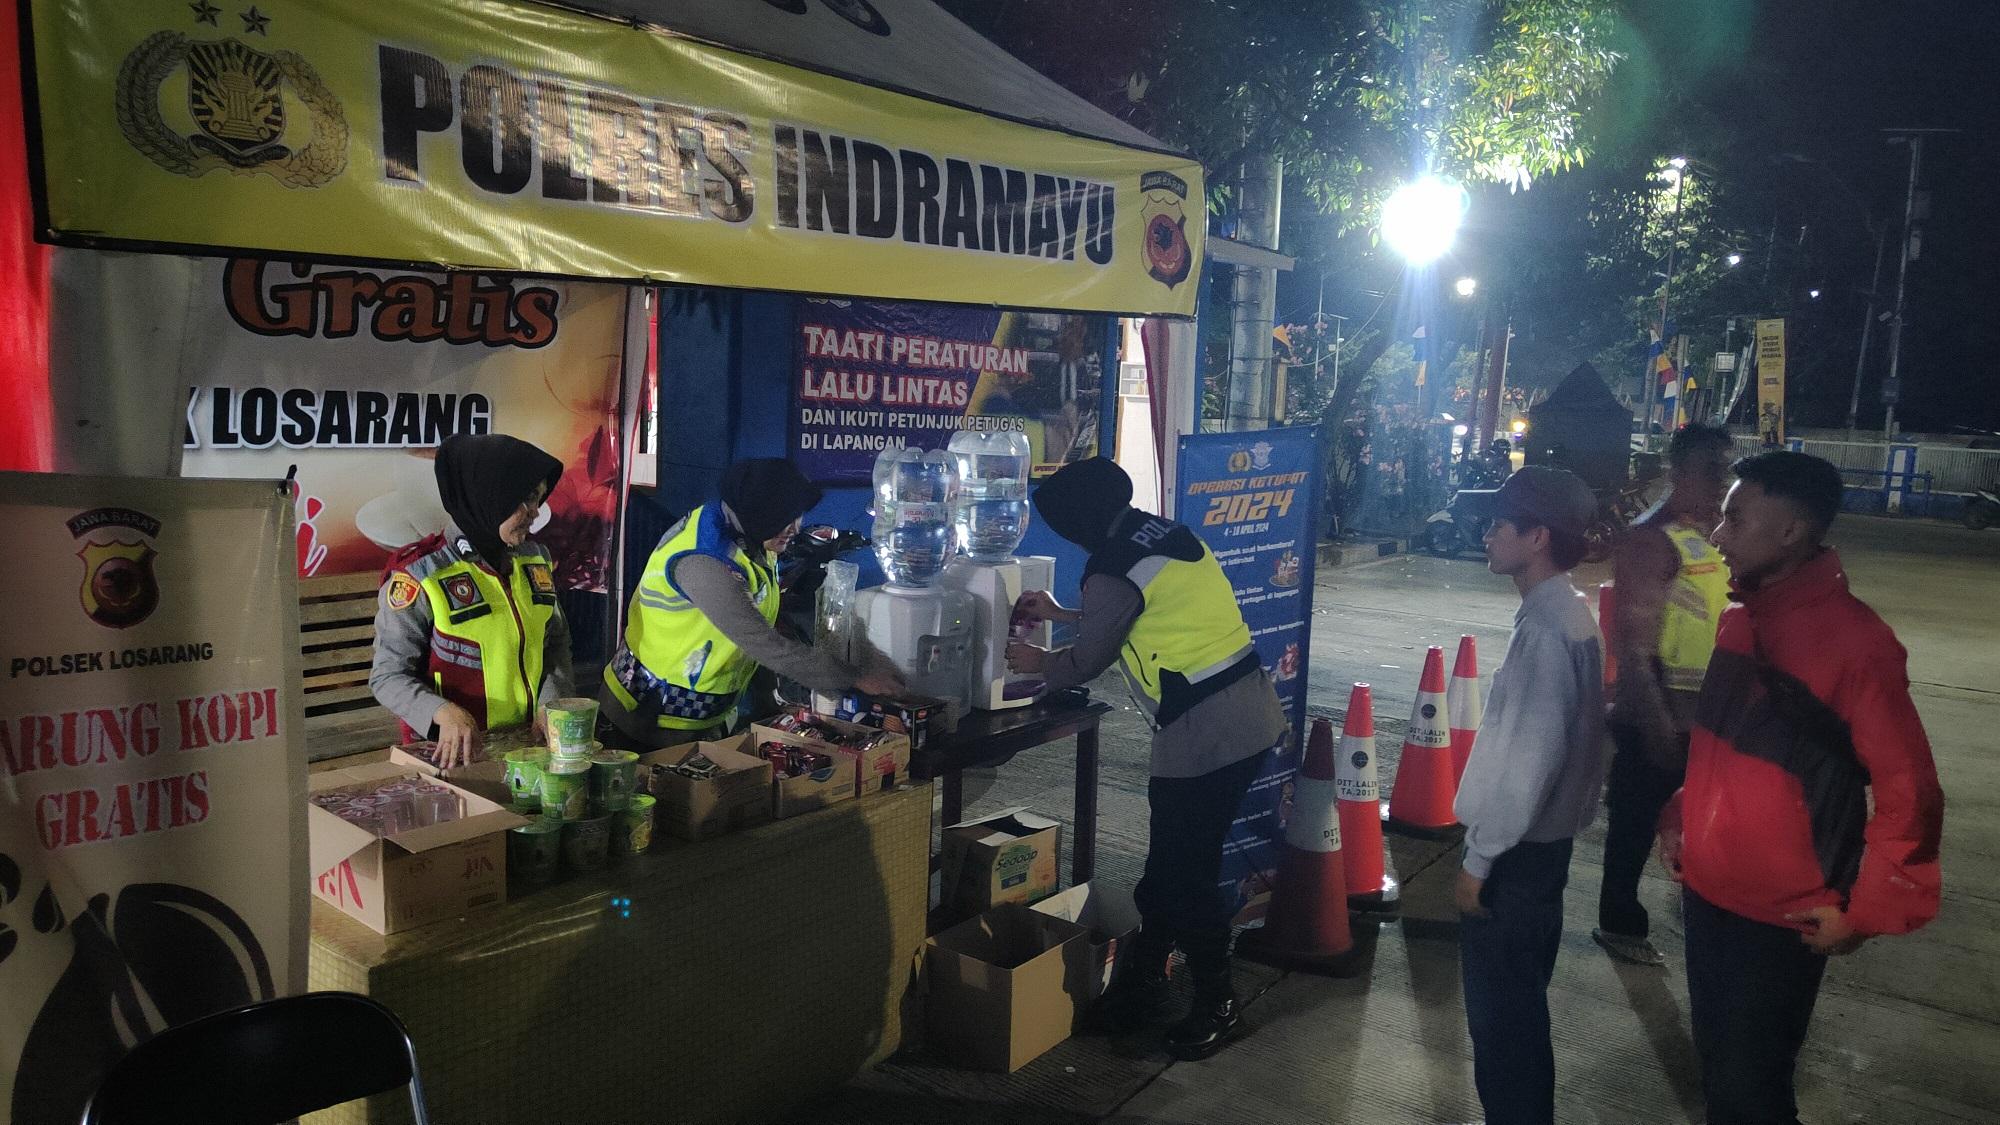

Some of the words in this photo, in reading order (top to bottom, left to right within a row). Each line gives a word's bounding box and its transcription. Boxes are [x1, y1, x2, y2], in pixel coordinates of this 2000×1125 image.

[378, 44, 755, 223] POLRES
[774, 124, 1115, 264] INDRAMAYU
[223, 256, 558, 349] Gratis
[803, 325, 883, 361] TAATI
[892, 336, 1028, 374] PERATURAN
[803, 369, 874, 401] LALU
[882, 376, 968, 405] LINTAS
[213, 387, 489, 445] LOSARANG
[801, 408, 835, 427] DAN
[841, 410, 883, 427] IKUTI
[888, 412, 964, 430] PETUNJUK
[966, 415, 1024, 432] PETUGAS
[801, 433, 817, 449] DI
[823, 434, 906, 450] LAPANGAN
[1188, 479, 1247, 495] OPERASI
[1249, 472, 1309, 488] KETUPAT
[74, 513, 108, 532] JAWA
[111, 512, 156, 531] BARAT
[1203, 488, 1296, 527] 2024
[1131, 519, 1172, 549] POL
[11, 651, 104, 679] POLSEK
[110, 642, 214, 670] LOSARANG
[0, 702, 161, 777] ARUNG
[177, 688, 279, 751] KOPI
[35, 770, 210, 851] GRATIS
[1341, 787, 1376, 797] TA.2017
